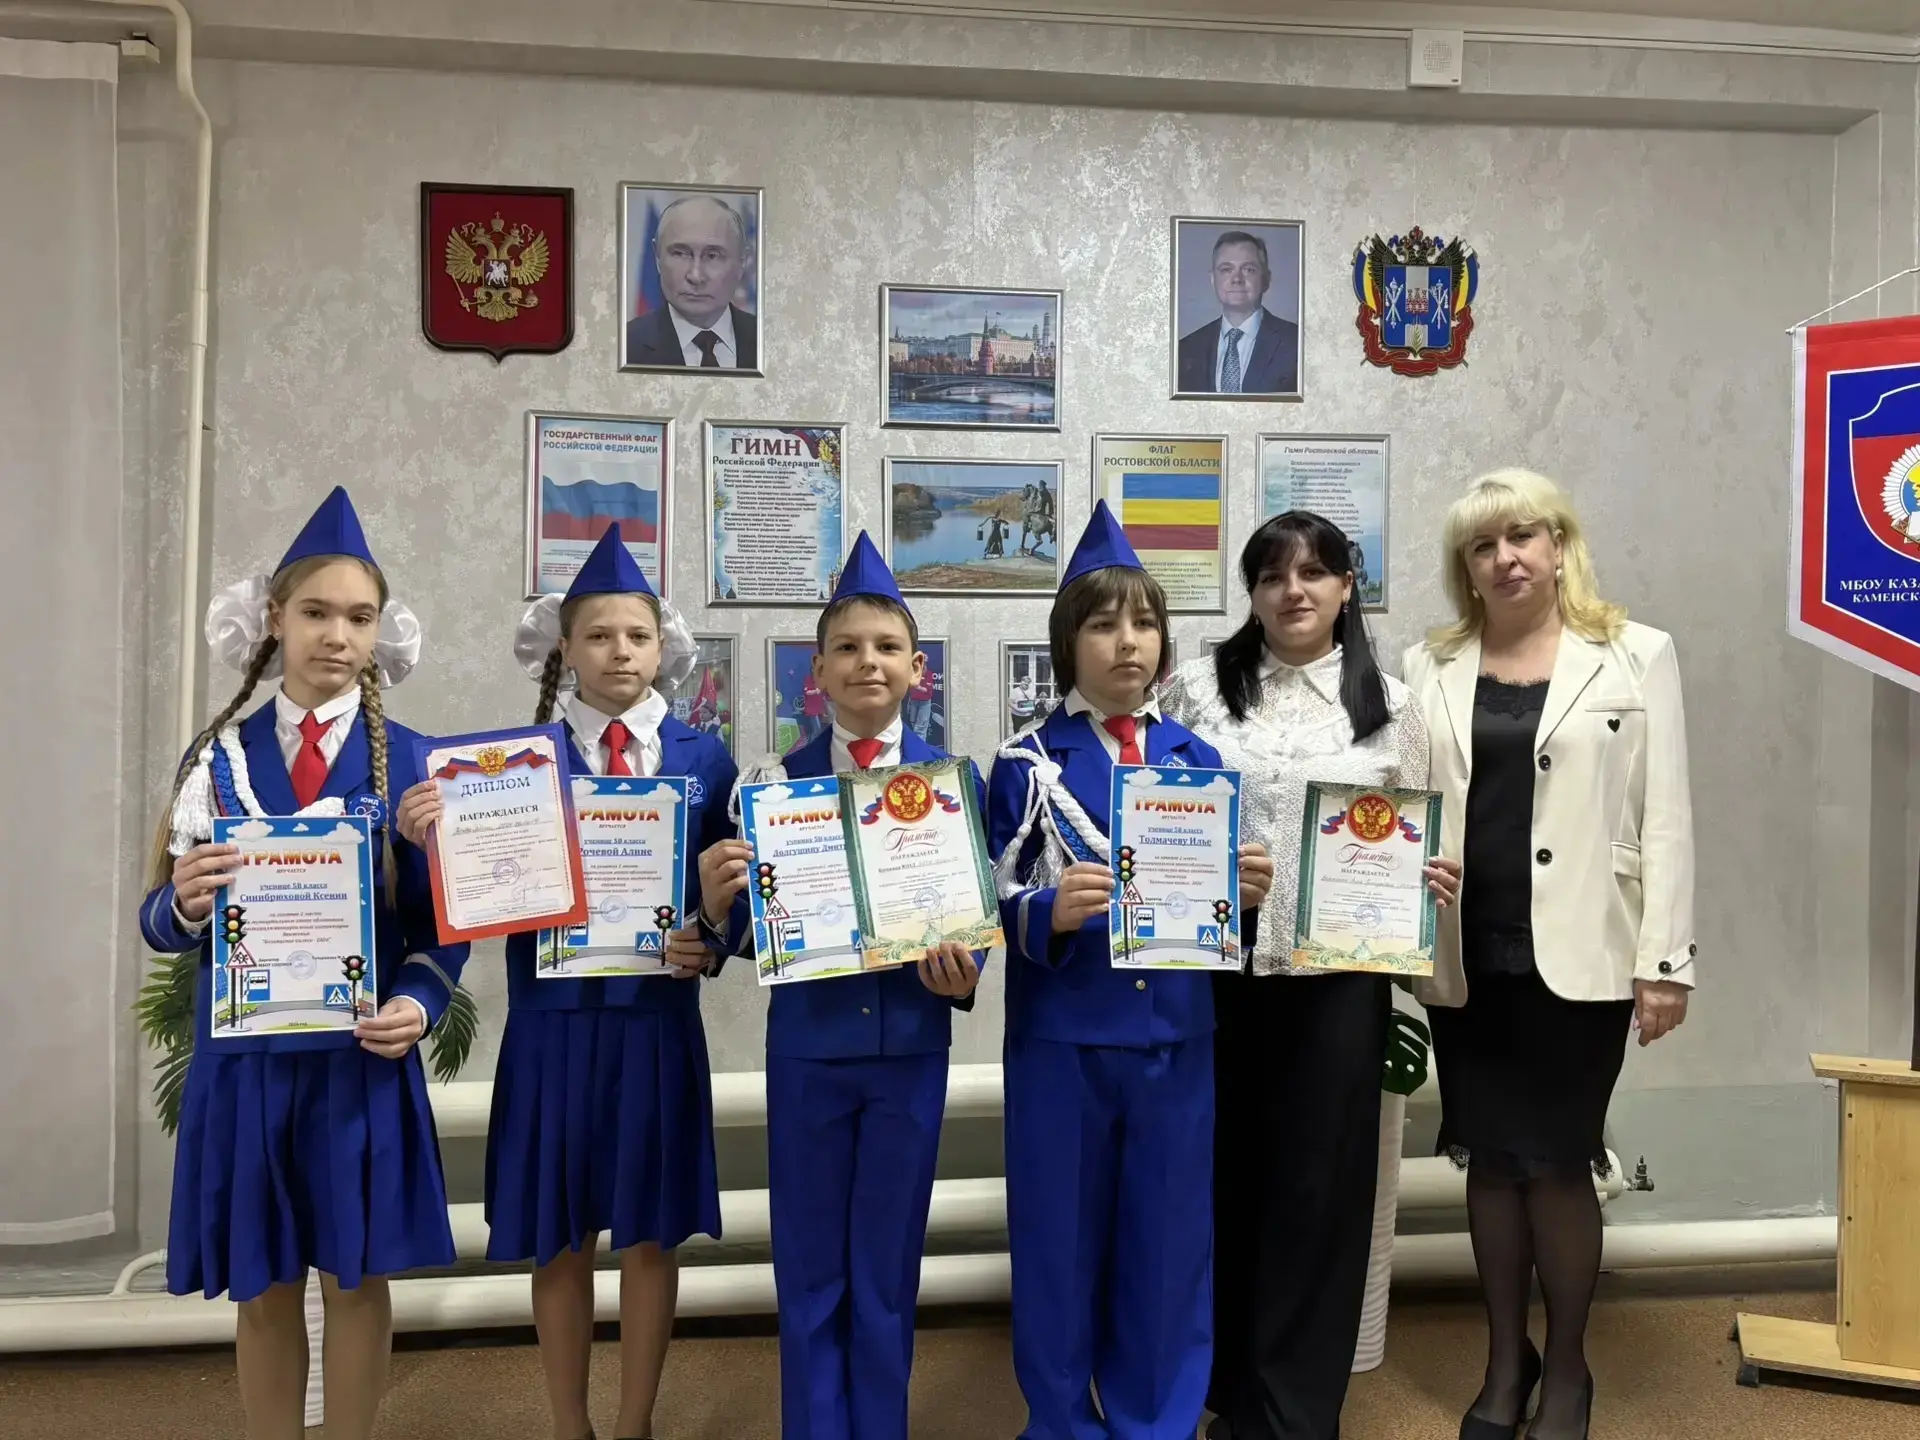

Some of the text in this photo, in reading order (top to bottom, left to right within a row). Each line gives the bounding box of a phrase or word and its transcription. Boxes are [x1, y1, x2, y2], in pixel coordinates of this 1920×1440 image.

[544, 430, 658, 443] ГОСУДАРСТВЕННЫЙ ФЛАГ
[544, 441, 658, 454] РОССИЙСКОЙ ФЕДЕРАЦИИ
[731, 437, 802, 456] ГИМН
[1149, 445, 1176, 454] ФЛАГ
[1284, 446, 1379, 455] Гимн Ростовской области
[713, 456, 820, 468] Российской Федерации
[1104, 456, 1220, 468] РОСТОВСКОЙ ОБЛАСТИ
[1840, 577, 1920, 591] МБОУ КАЗ
[1853, 592, 1920, 603] КАМЕНСК
[461, 776, 531, 798] ДИПЛОМ
[360, 796, 379, 806] ЮИД
[1135, 796, 1216, 814] ГРАМОТА
[460, 804, 539, 822] НАГРАЖДАЕТСЯ
[579, 807, 660, 821] РАМОТА
[768, 808, 843, 827] ГРАМОТ
[1139, 835, 1212, 847] Толмачеву Илье
[242, 848, 343, 866] ГРАМОТА
[620, 847, 653, 857] Алине
[313, 891, 347, 901] Ксении
